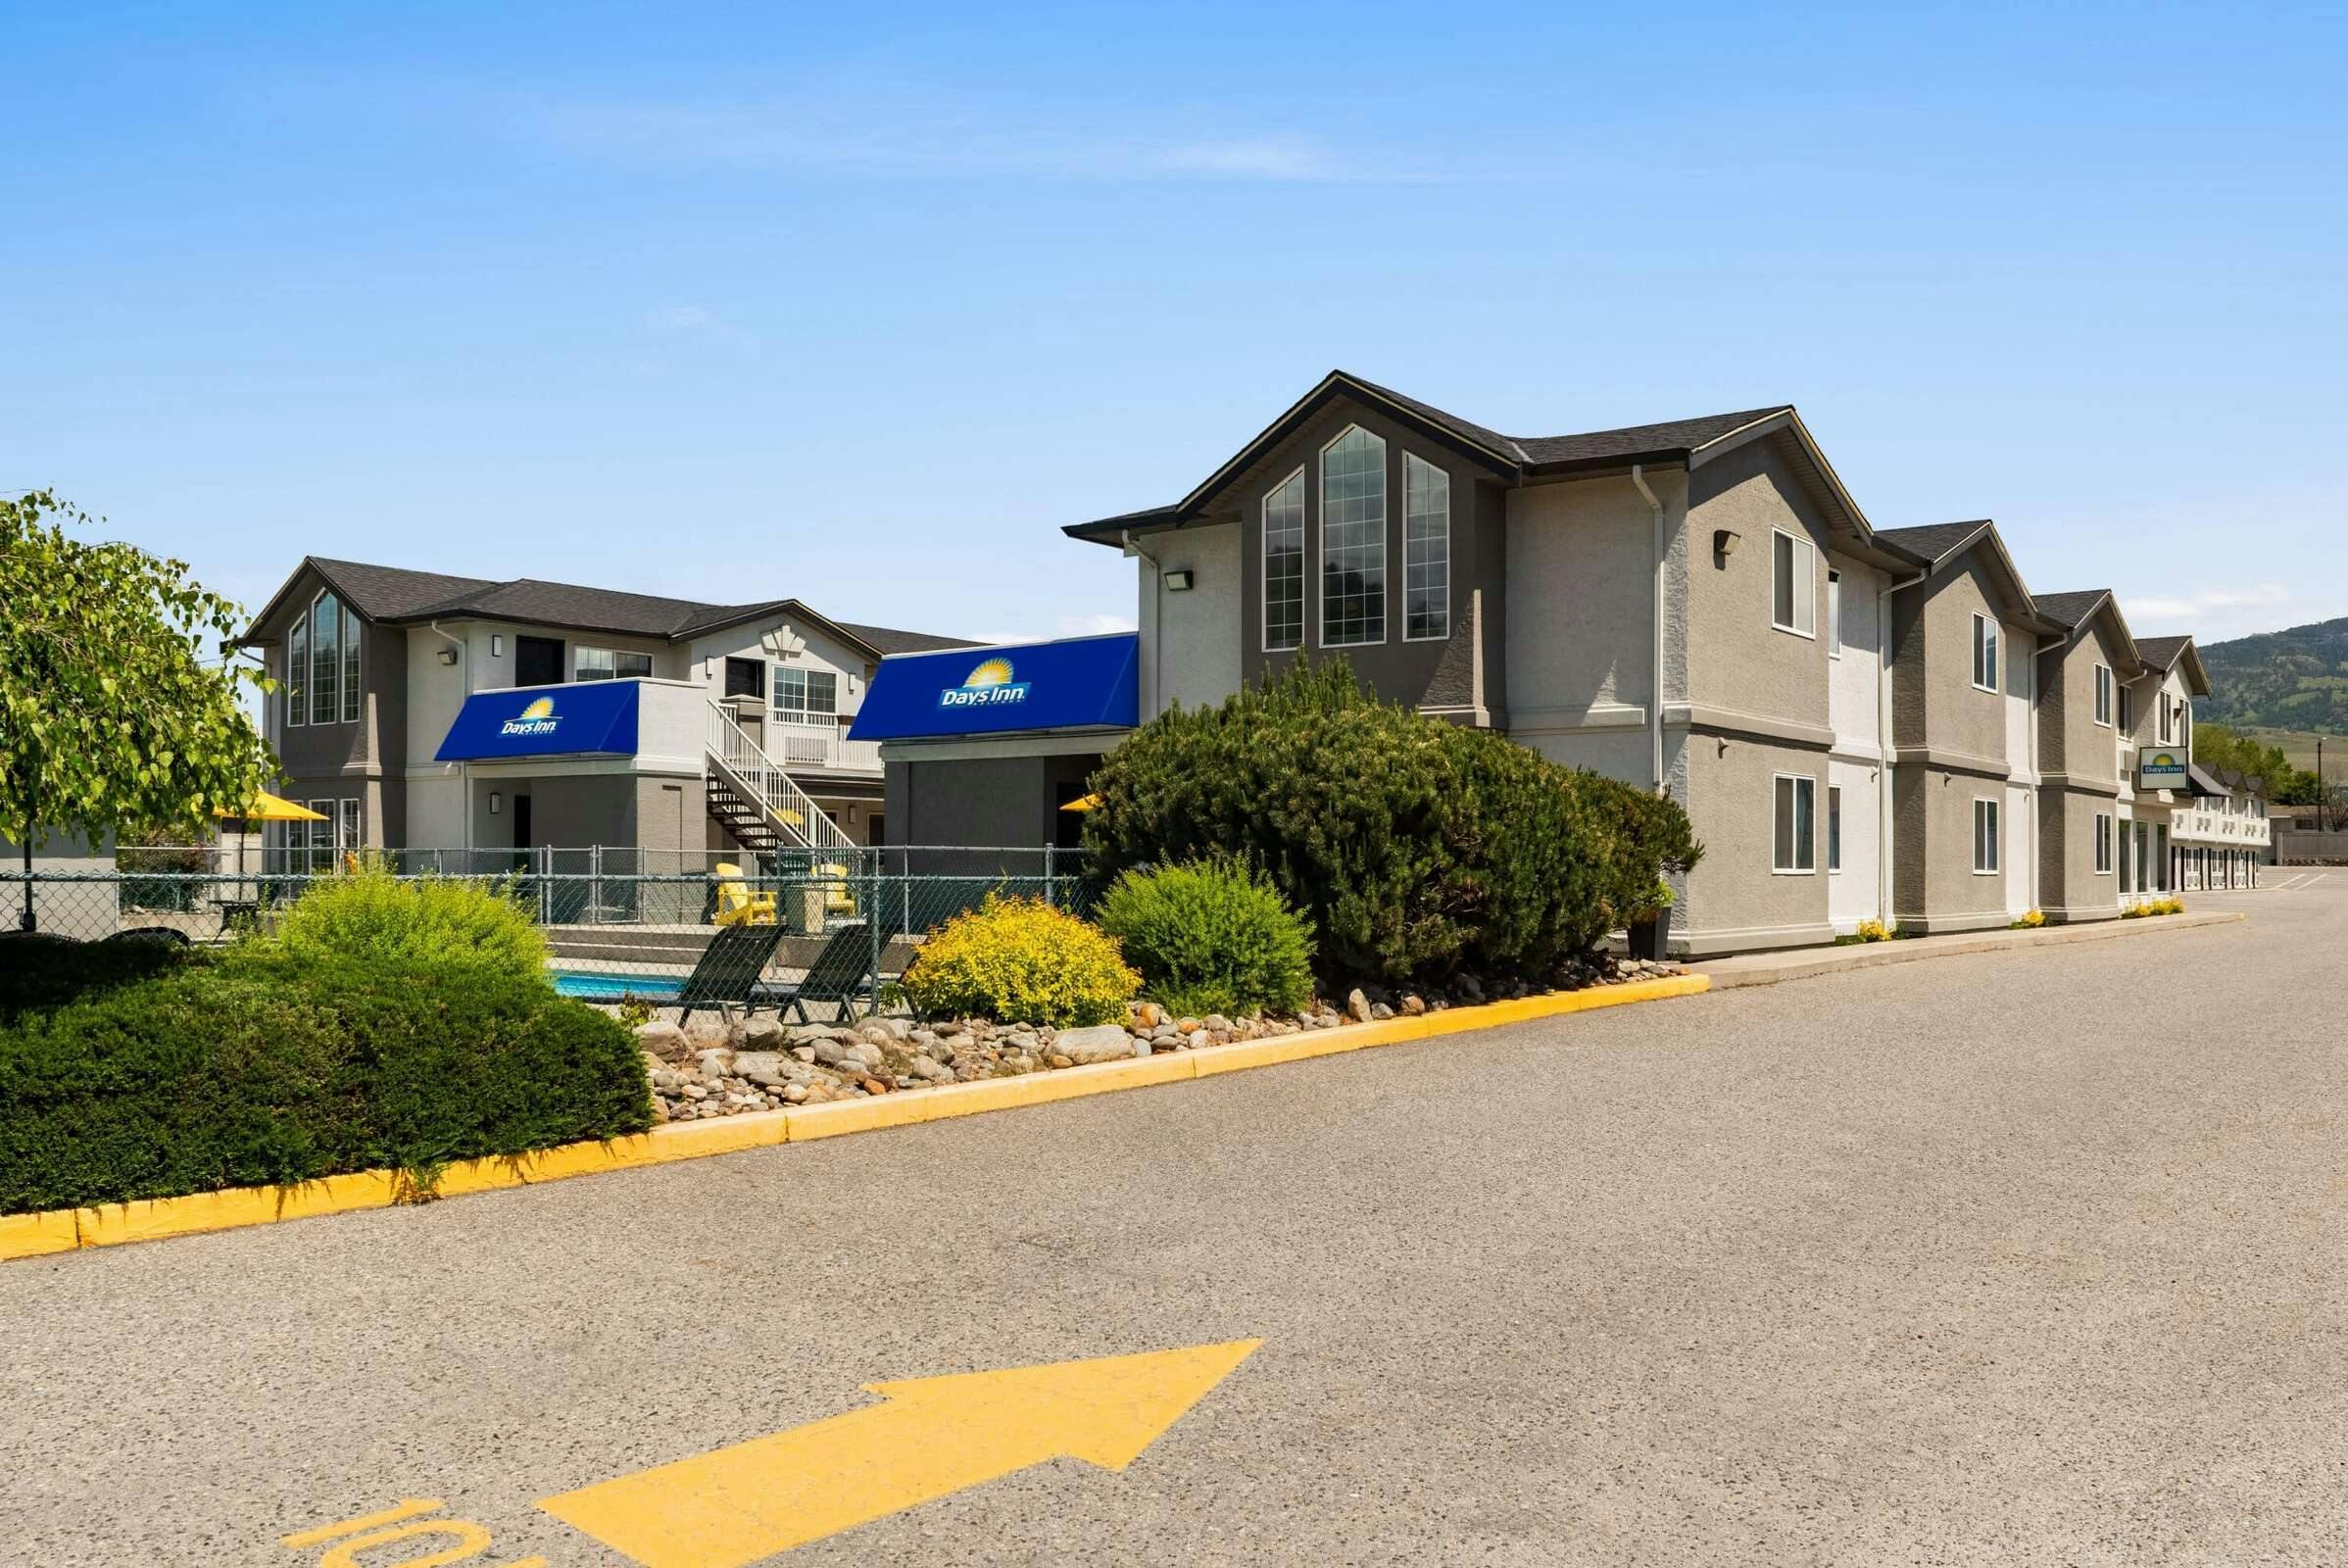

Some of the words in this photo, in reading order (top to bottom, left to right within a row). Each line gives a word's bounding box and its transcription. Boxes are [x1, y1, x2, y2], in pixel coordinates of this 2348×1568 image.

[942, 690, 990, 706] Days
[990, 687, 1024, 702] Inn
[501, 722, 534, 735] Days
[532, 720, 557, 732] Inn
